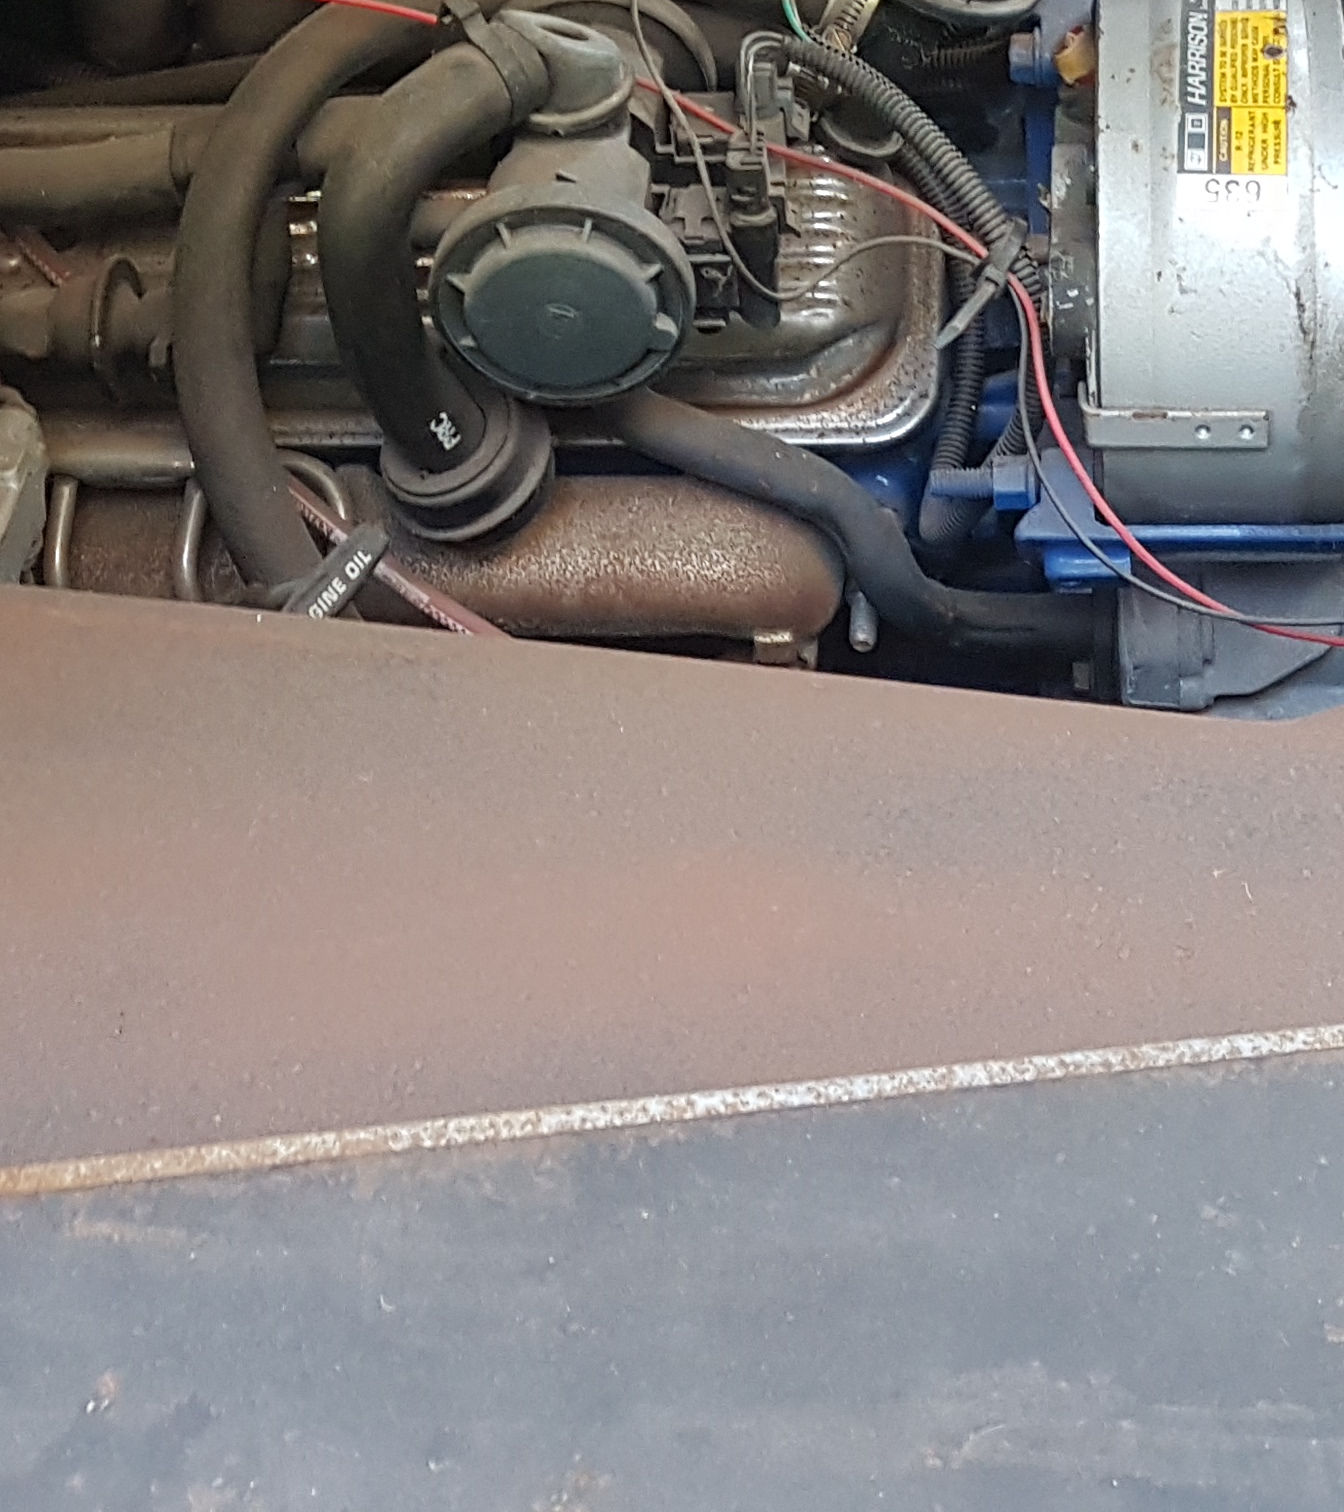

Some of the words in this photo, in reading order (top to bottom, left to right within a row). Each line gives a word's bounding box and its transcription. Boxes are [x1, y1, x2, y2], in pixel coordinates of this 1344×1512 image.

[1187, 11, 1209, 105] HARRISON
[1219, 61, 1227, 69] TO
[1219, 73, 1227, 102] SYSTEM
[1231, 94, 1237, 103] BY
[1219, 119, 1228, 161] CAUTION
[1272, 120, 1281, 164] PRESSURE
[308, 576, 347, 620] GINE
[344, 549, 373, 579] OIL
